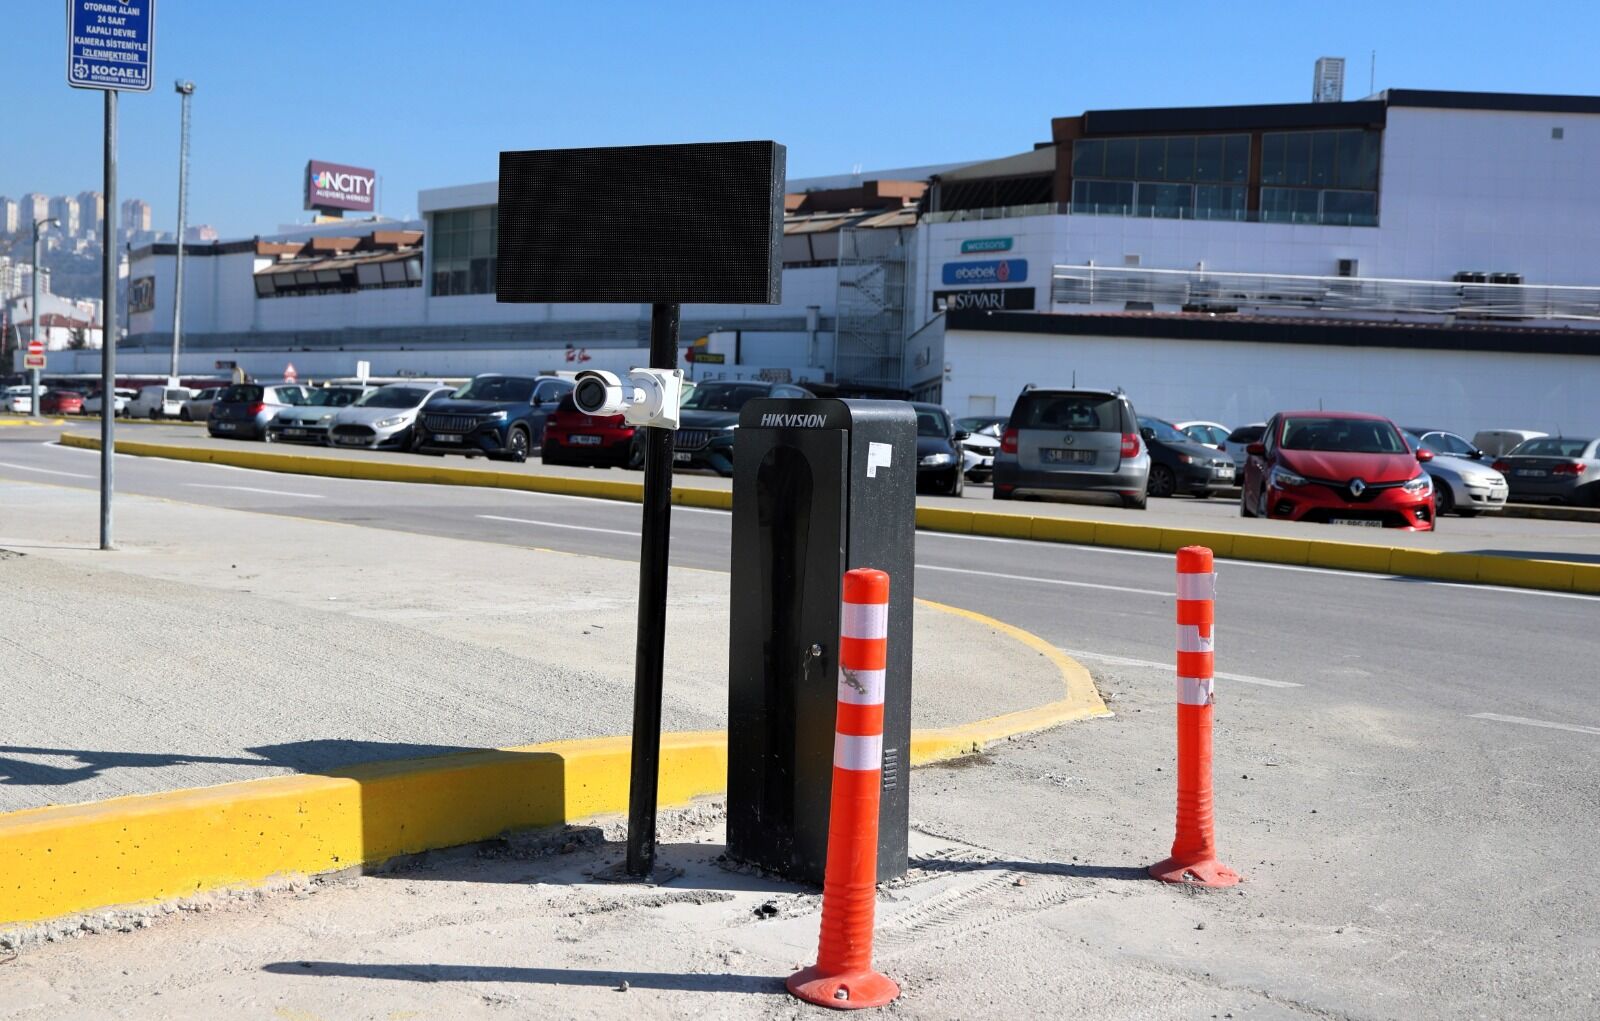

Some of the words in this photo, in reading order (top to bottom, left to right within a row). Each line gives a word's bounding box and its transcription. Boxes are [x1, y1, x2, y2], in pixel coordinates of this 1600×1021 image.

[84, 2, 117, 13] OTOPARK
[118, 6, 140, 16] ALANI
[97, 15, 106, 23] 24
[107, 16, 126, 25] SAAT
[86, 25, 112, 35] KAPALI
[113, 28, 136, 38] DEVRE
[74, 36, 105, 47] KAMERA
[106, 38, 148, 51] SİSTEMİYLE
[82, 47, 140, 62] İZLENMEKTEDİR
[91, 65, 146, 79] KOCAELİ
[966, 240, 1006, 250] watsons
[955, 265, 997, 279] ebebek
[760, 413, 827, 428] HIKVISION
